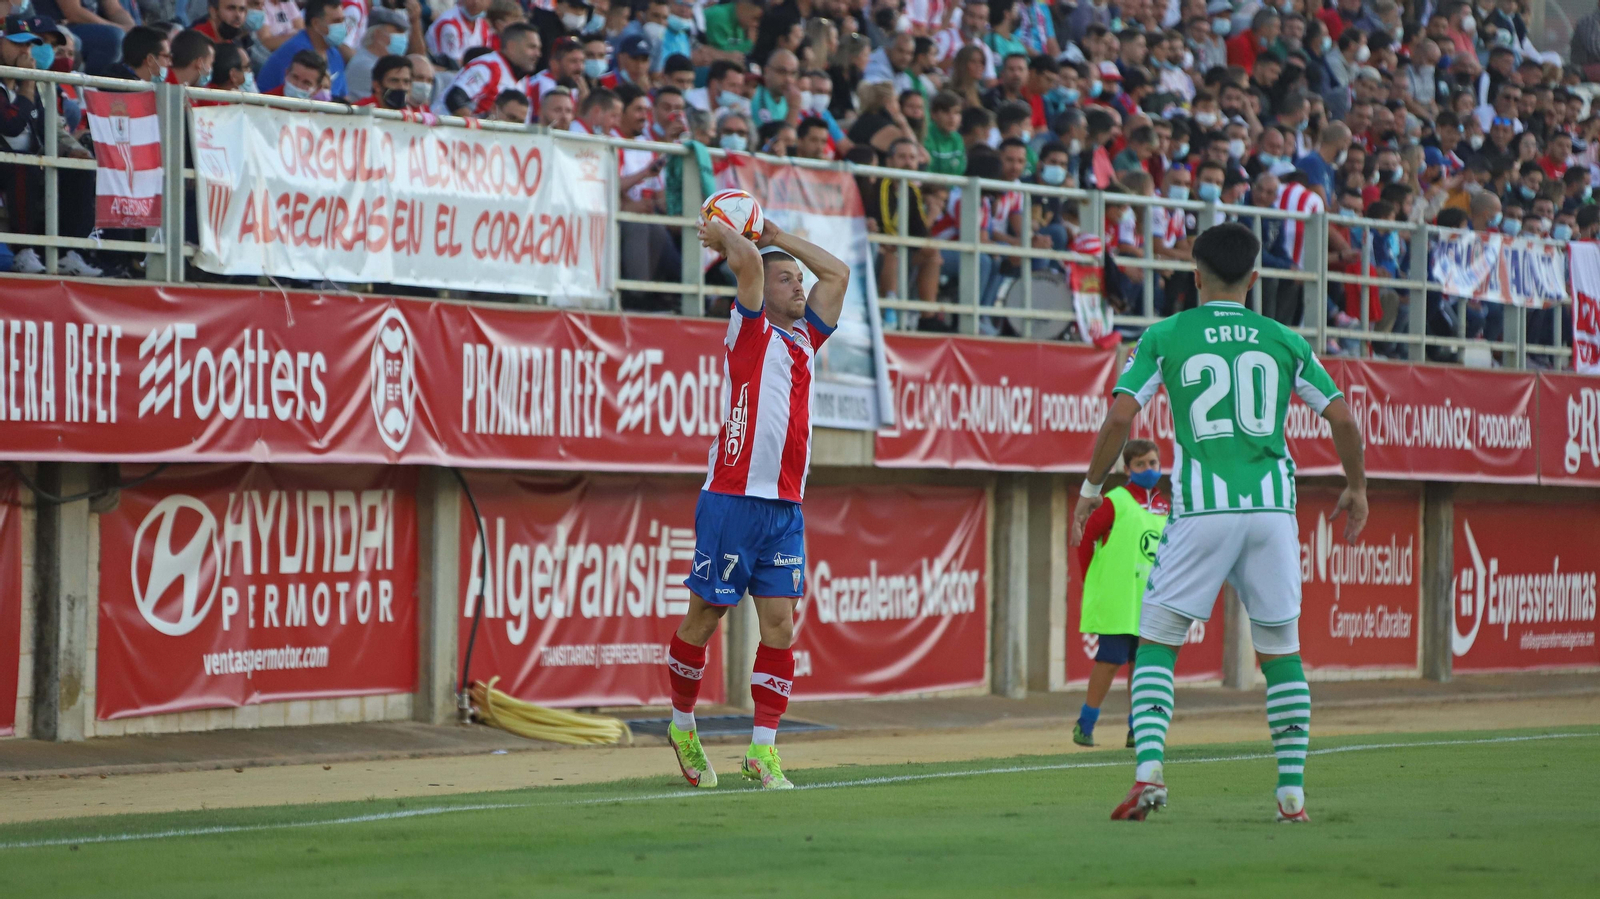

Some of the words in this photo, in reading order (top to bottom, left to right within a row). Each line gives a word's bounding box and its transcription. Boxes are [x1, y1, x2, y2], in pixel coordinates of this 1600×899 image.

[238, 189, 389, 254] ALGECIRAS
[391, 199, 424, 257] EN
[434, 203, 462, 259] EL
[471, 209, 582, 269] CORAZON
[65, 322, 122, 423] RFEF
[173, 323, 327, 423] Footters
[1204, 324, 1260, 345] CRUZ
[462, 342, 555, 436] PRIMERA
[560, 349, 607, 438] RFEF
[644, 350, 725, 437] Foott
[1181, 351, 1279, 443] 20
[223, 490, 394, 577] HYUNDAI
[721, 553, 739, 582] 7
[221, 580, 394, 631] PERMOTOR
[464, 516, 671, 646] Algetransit
[814, 560, 919, 624] Grazalema
[921, 557, 979, 618] Motor
[1488, 554, 1597, 641] Expressreformas
[203, 644, 329, 680] ventaspermotor.com
[1329, 603, 1363, 647] Campo
[1364, 605, 1375, 638] de
[1376, 604, 1412, 639] Gibraltar
